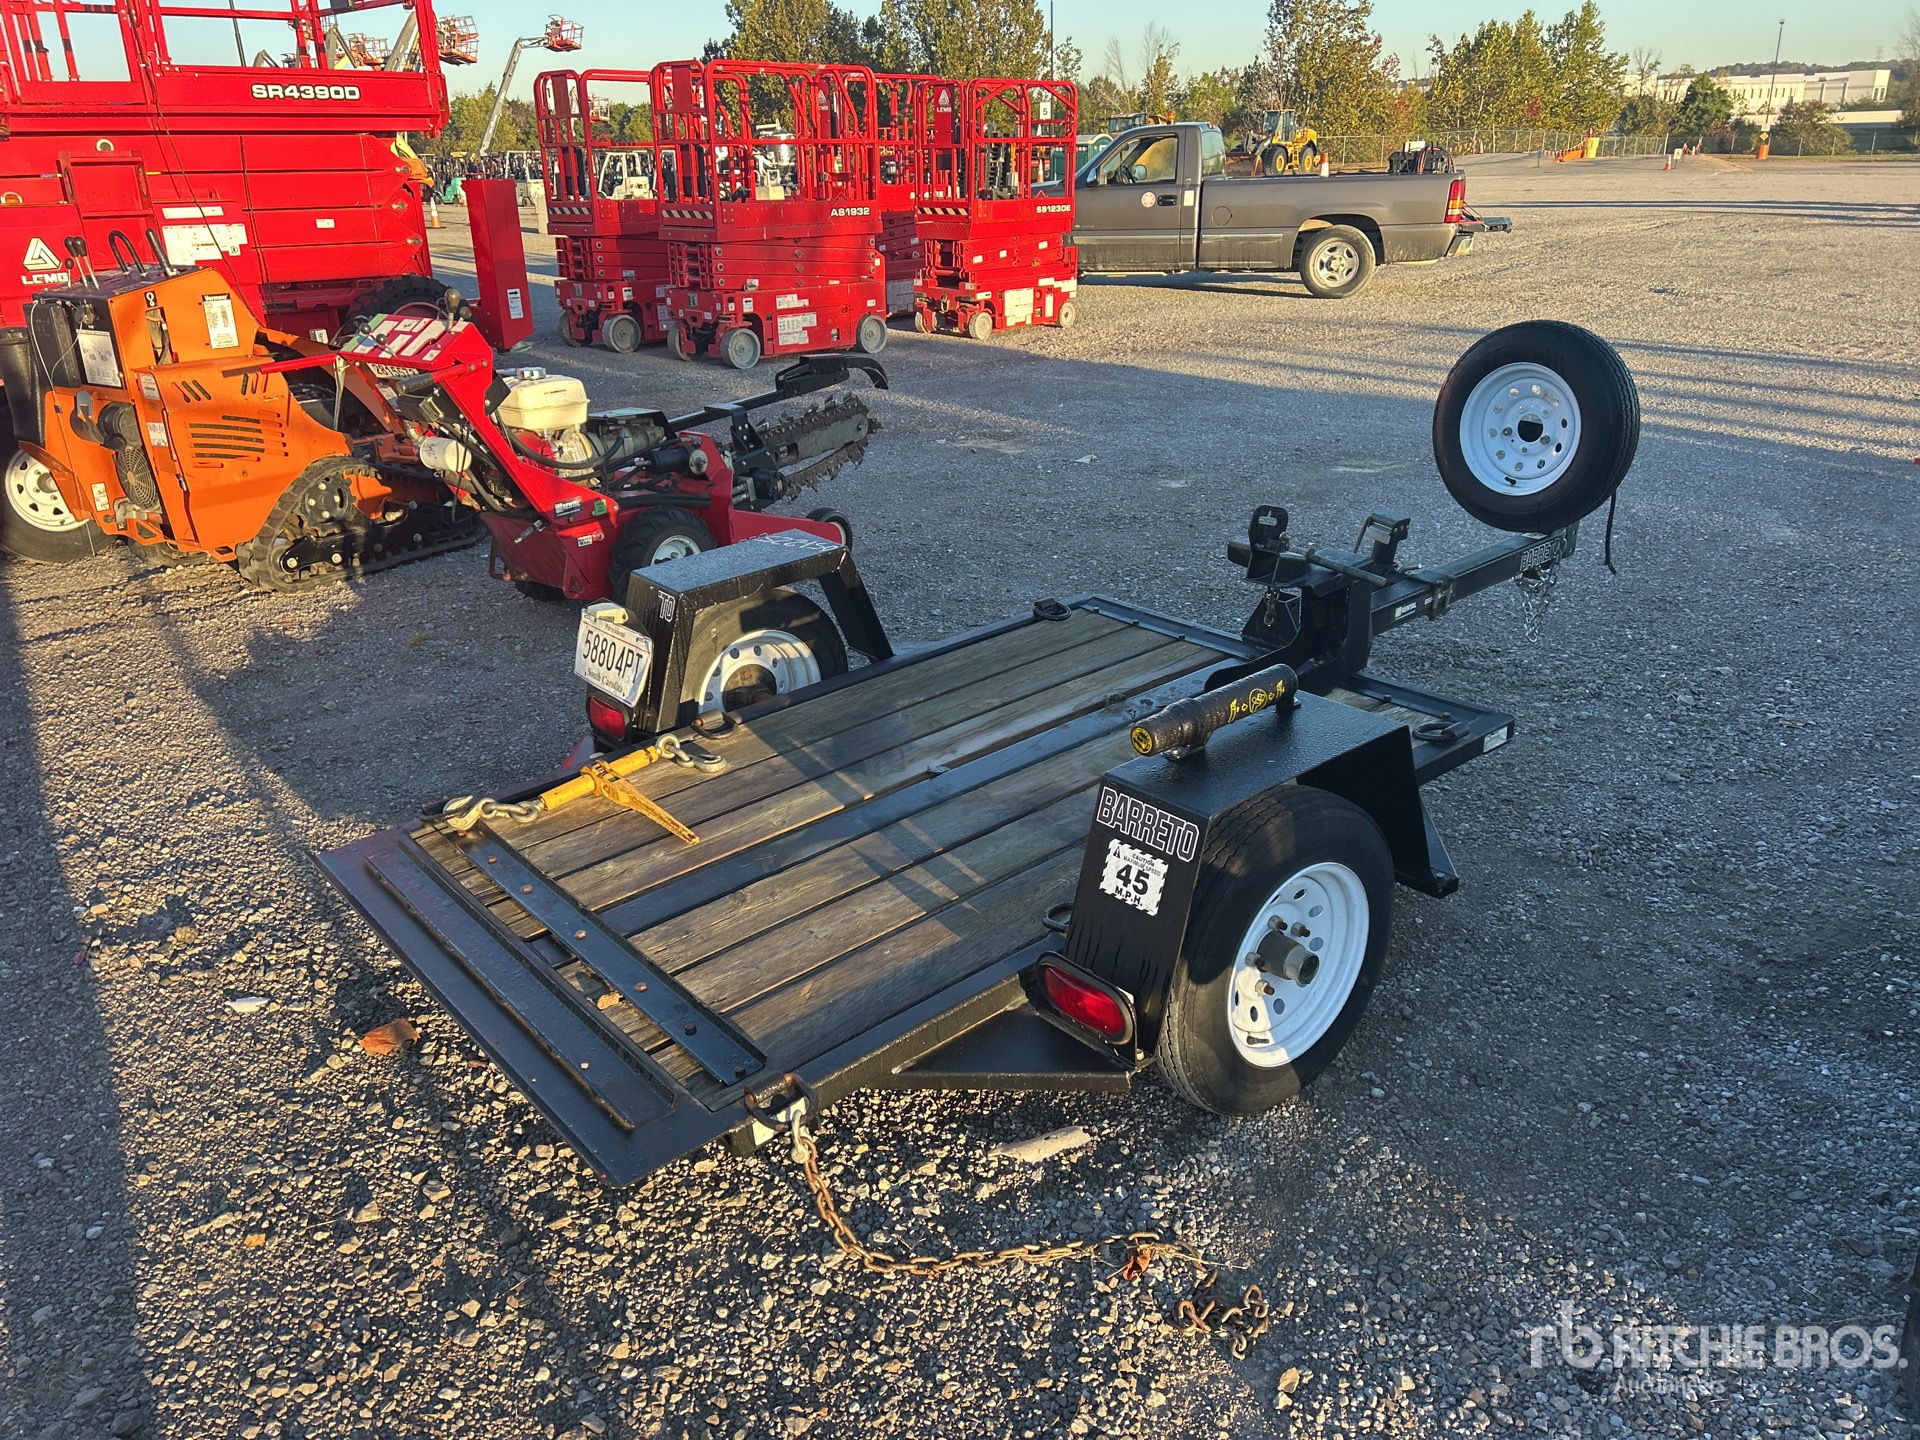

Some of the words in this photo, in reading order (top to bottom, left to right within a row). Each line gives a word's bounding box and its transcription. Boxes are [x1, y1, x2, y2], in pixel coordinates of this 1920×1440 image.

[251, 83, 361, 100] SR4390D
[1042, 108, 1048, 116] 5
[830, 207, 870, 217] AS1932
[582, 629, 643, 684] 58804PT
[587, 667, 601, 682] South
[602, 675, 623, 694] Carolina
[1097, 786, 1200, 862] BARRETO
[1132, 853, 1155, 868] CAUTION
[1115, 864, 1150, 896] 45
[1145, 865, 1161, 877] SPEED
[1114, 885, 1143, 907] M.P.H.
